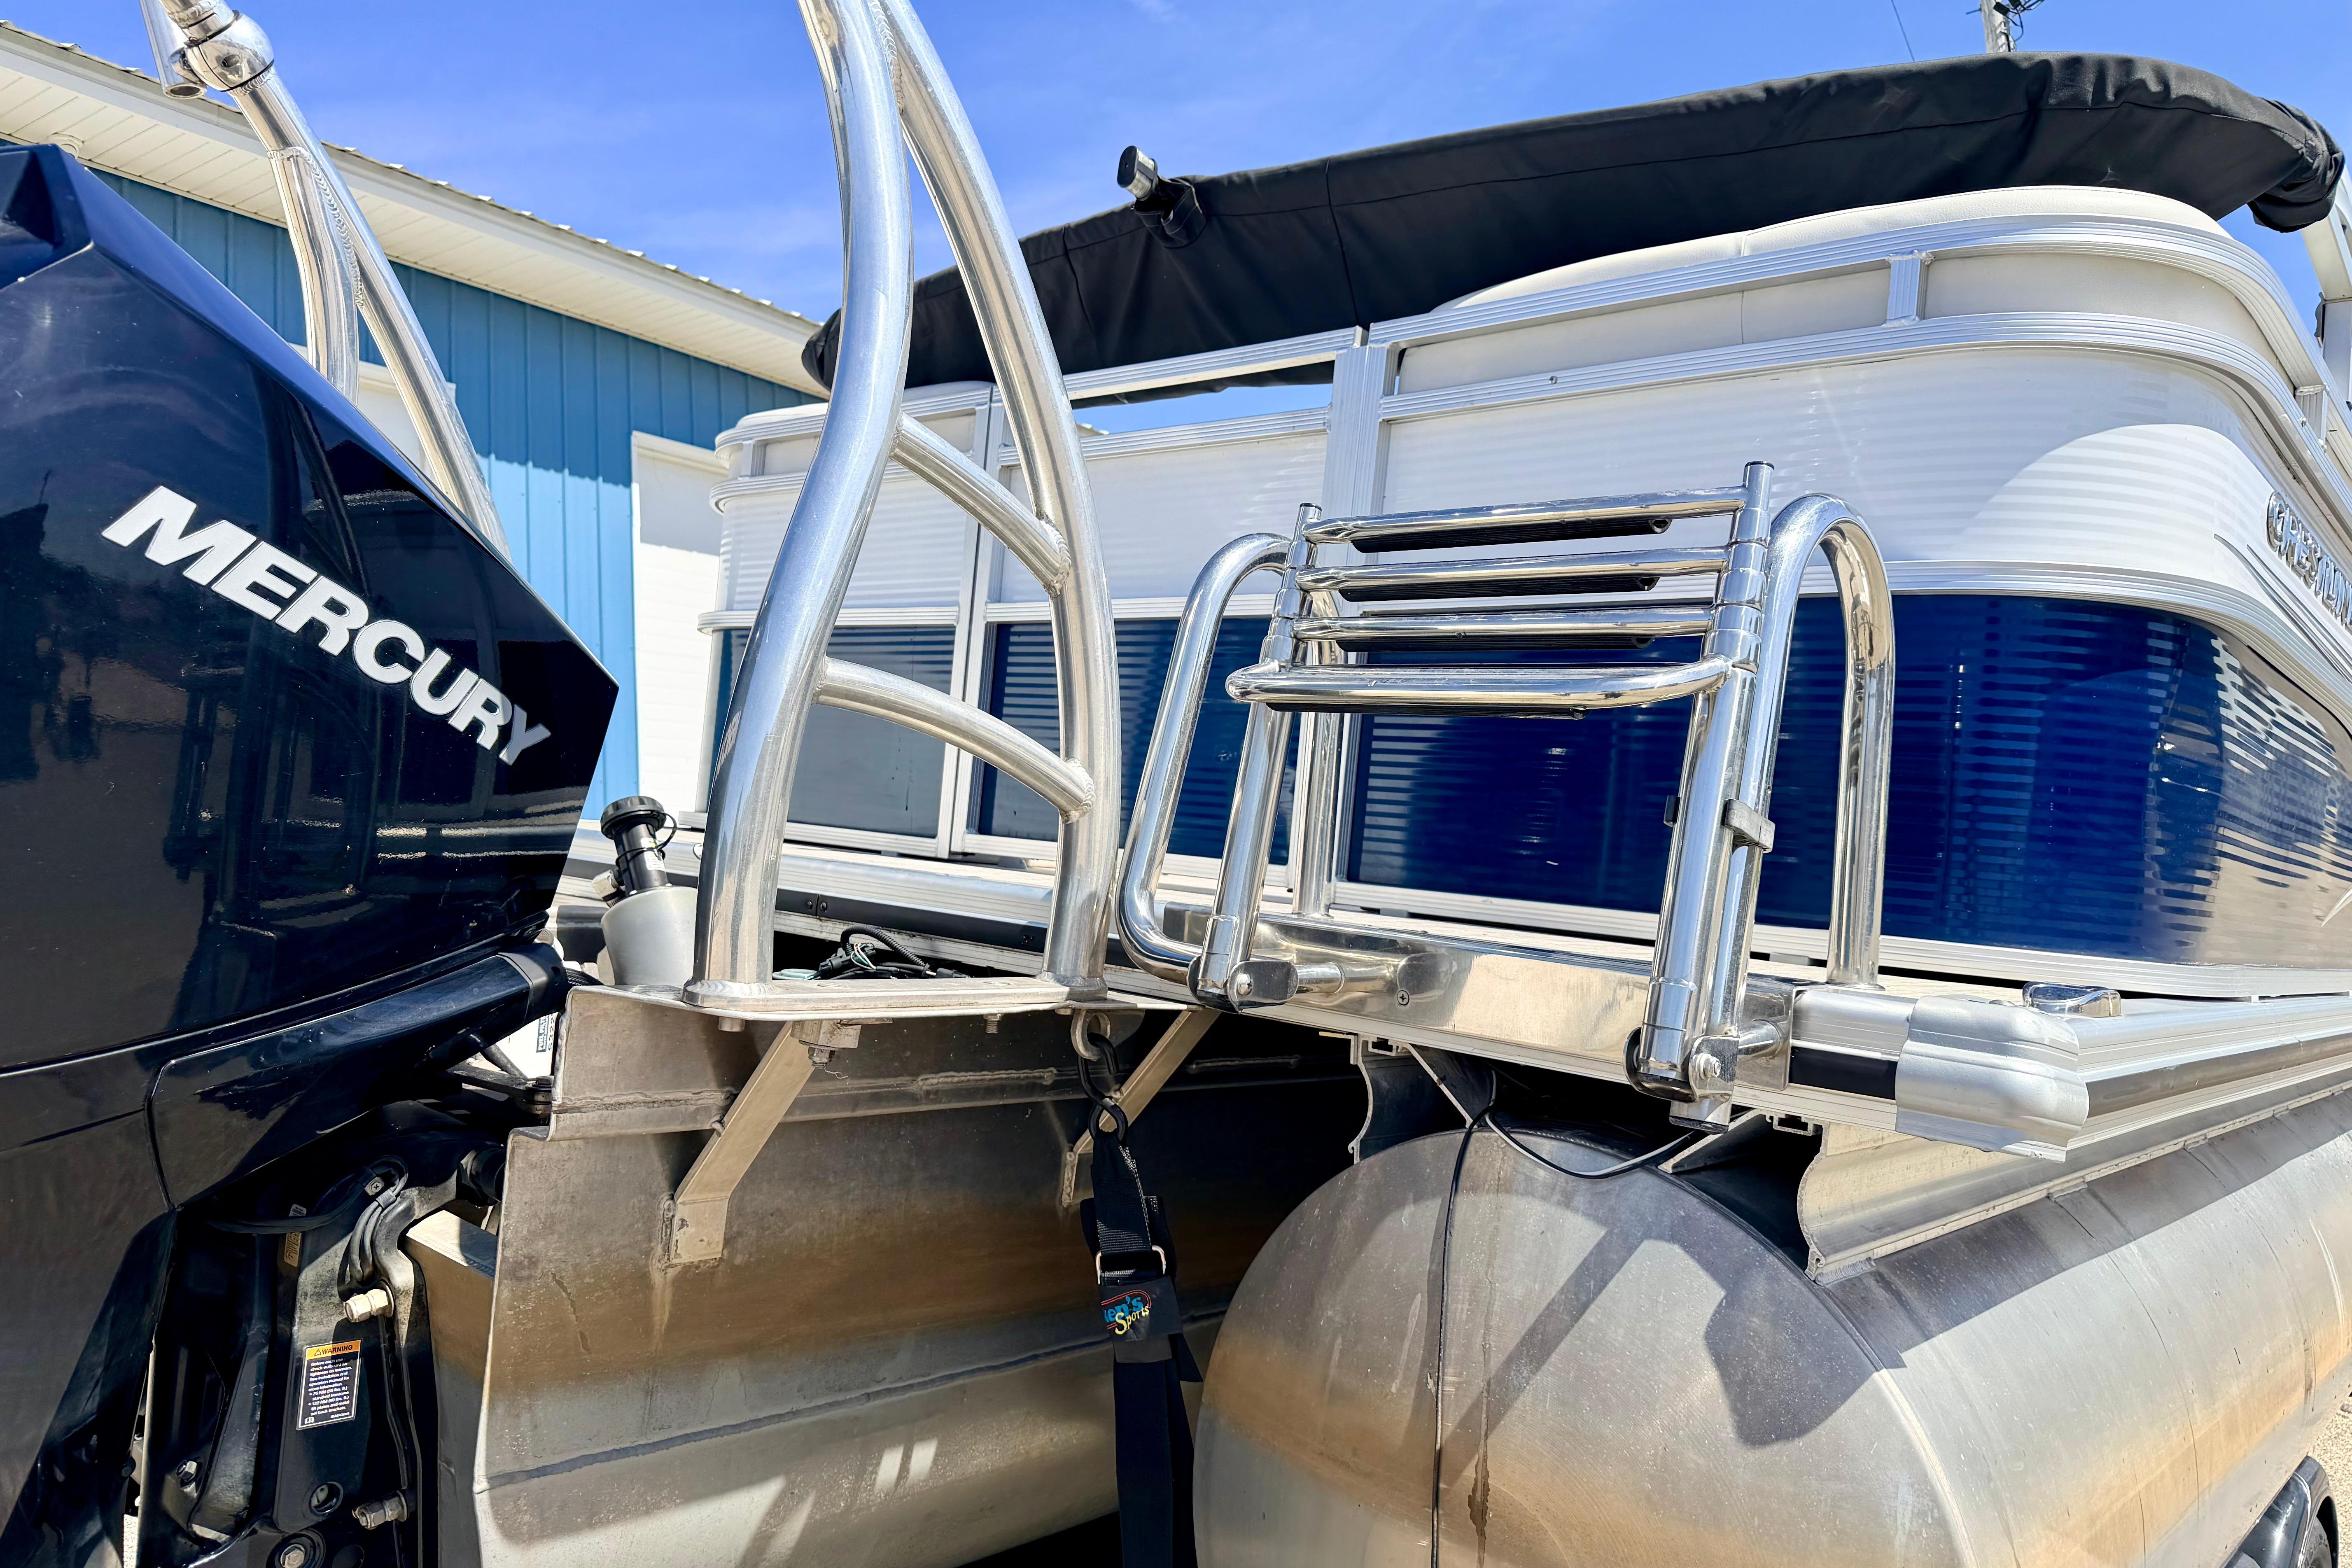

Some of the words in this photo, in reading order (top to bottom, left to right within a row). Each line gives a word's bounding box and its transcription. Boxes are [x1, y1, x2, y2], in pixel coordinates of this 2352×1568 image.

[101, 485, 551, 765] MERCURY
[1115, 1306, 1149, 1334] Sports
[322, 1345, 352, 1354] WARNING
